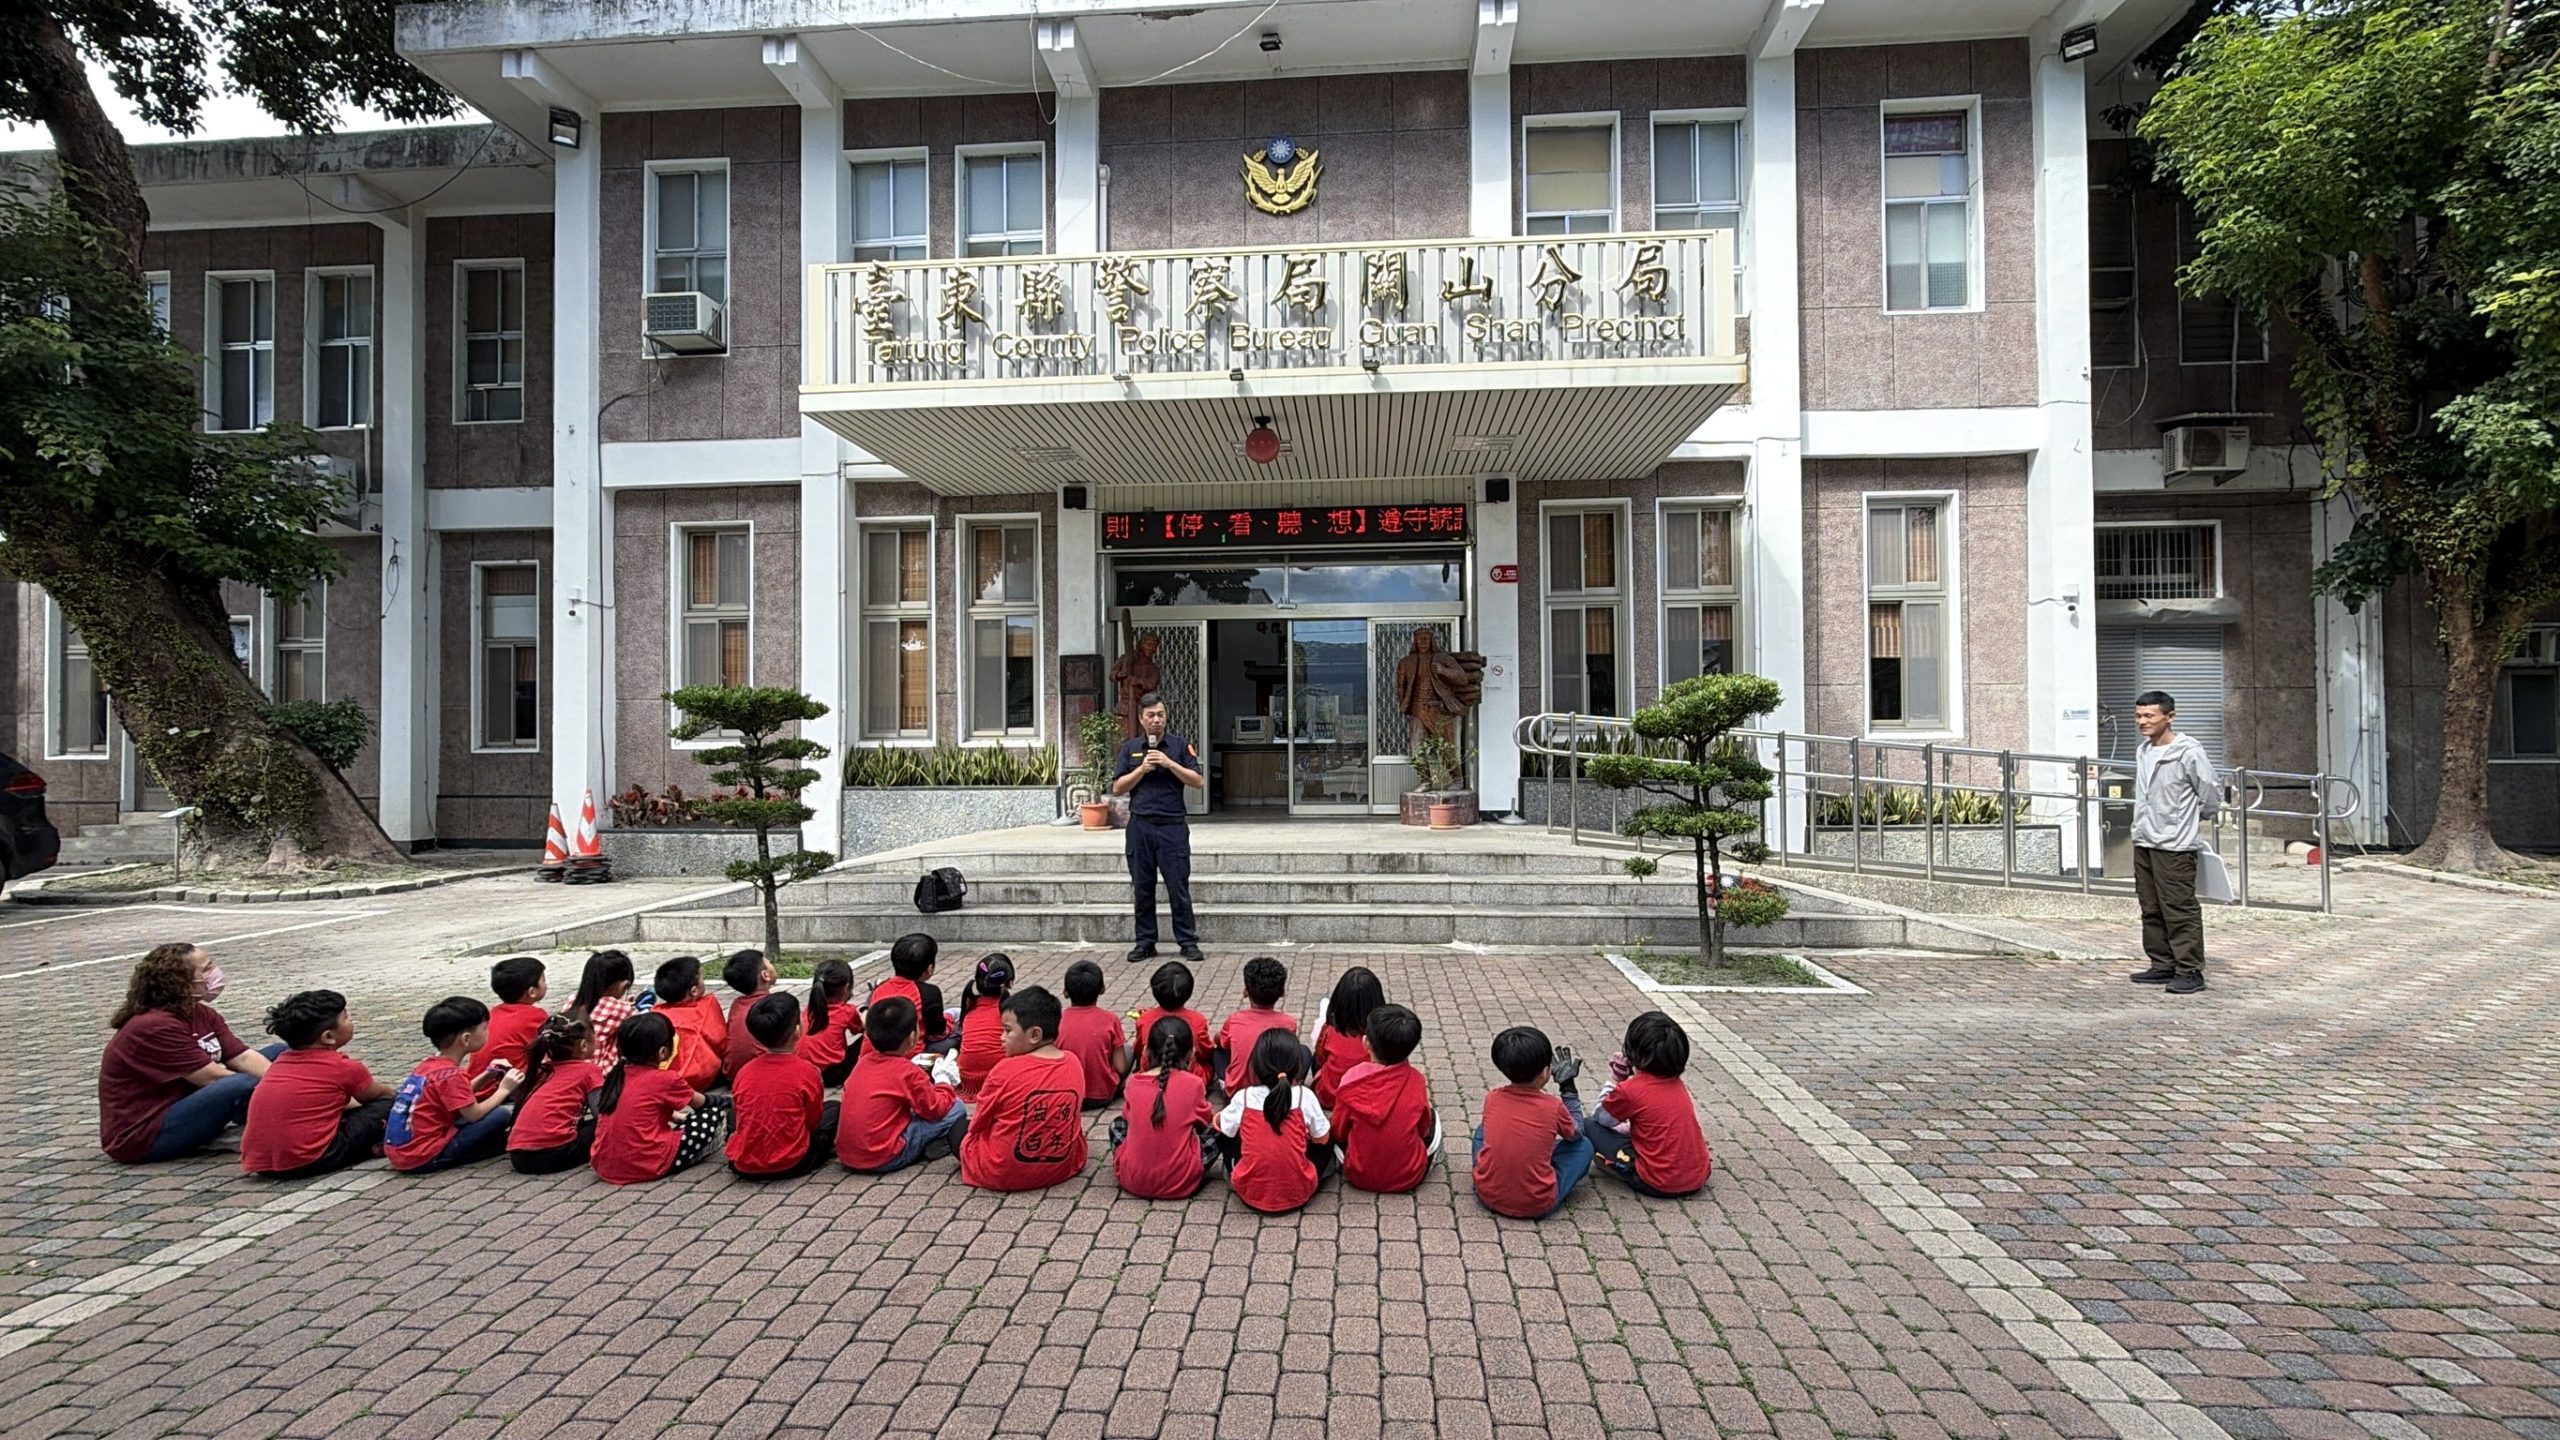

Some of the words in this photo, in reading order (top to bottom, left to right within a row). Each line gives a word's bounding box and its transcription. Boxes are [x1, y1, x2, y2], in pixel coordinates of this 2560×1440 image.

[853, 241, 1672, 341] 臺東縣警察局關山分局
[863, 335, 967, 365] Taitung
[992, 329, 1094, 360] County
[1119, 326, 1206, 355] Police
[1229, 321, 1332, 350] Bureau
[1359, 317, 1439, 347] Guan
[1465, 312, 1542, 342] Shan
[1561, 311, 1685, 342] Precinct
